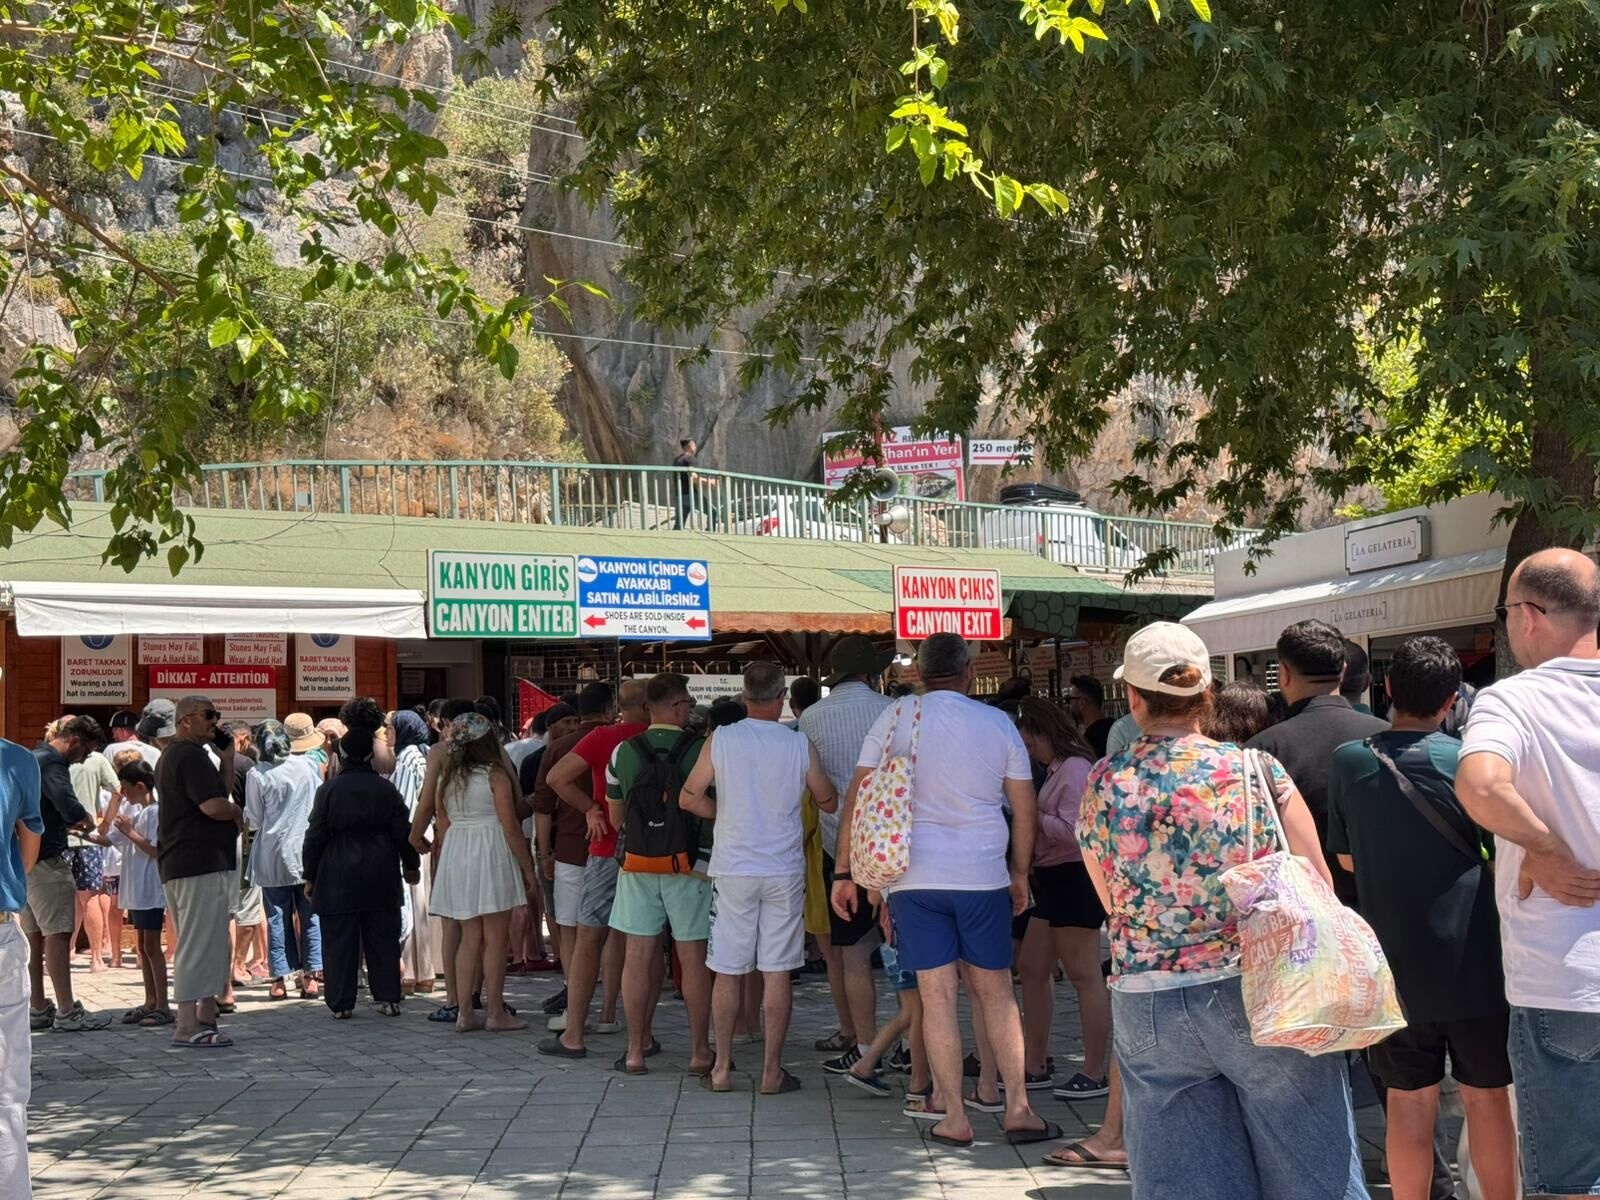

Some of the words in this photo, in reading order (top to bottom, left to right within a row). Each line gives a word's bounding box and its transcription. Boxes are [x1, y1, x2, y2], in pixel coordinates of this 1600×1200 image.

[933, 444, 957, 456] Yeri
[972, 443, 993, 453] 250
[1356, 547, 1365, 556] LA
[1368, 536, 1412, 554] GELATERIA
[599, 561, 646, 575] KANYON
[648, 560, 685, 577] İÇİNDE
[440, 561, 516, 590] KANYON
[521, 558, 570, 598] GİRİŞ
[616, 577, 671, 591] AYAKKABI
[902, 575, 956, 600] KANYON
[959, 577, 995, 606] ÇIKIŞ
[587, 592, 620, 604] SATIN
[622, 590, 701, 607] ALABİLİRSİNİZ
[436, 602, 514, 632] CANYON
[518, 604, 574, 633] ENTER
[604, 611, 628, 620] SHOES
[629, 611, 642, 620] ARE
[644, 612, 661, 621] SOLD
[663, 612, 686, 621] INSIDE
[1334, 613, 1343, 622] LA
[1344, 607, 1383, 621] GELATERIA
[906, 610, 961, 635] CANYON
[963, 611, 993, 636] EXIT
[624, 624, 637, 633] THE
[638, 625, 669, 634] CANYON.
[143, 642, 167, 651] Stones
[168, 642, 183, 653] May
[229, 643, 252, 652] Stones
[253, 643, 267, 654] May
[142, 655, 161, 663] Wear
[163, 655, 169, 663] A
[169, 655, 186, 663] Hard
[187, 655, 199, 663] Hat
[229, 655, 247, 664] Wear
[247, 655, 253, 664] A
[253, 655, 269, 664] Hard
[271, 656, 283, 664] Hat
[302, 665, 348, 673] ZORUNLUDUR
[157, 669, 197, 684] DİKKAT
[302, 675, 329, 683] Wearing
[70, 680, 100, 688] Wearing
[107, 679, 124, 687] hard
[317, 685, 353, 693] mandatory.
[66, 689, 78, 697] hat
[80, 689, 87, 697] is
[87, 690, 128, 698] mandatory.
